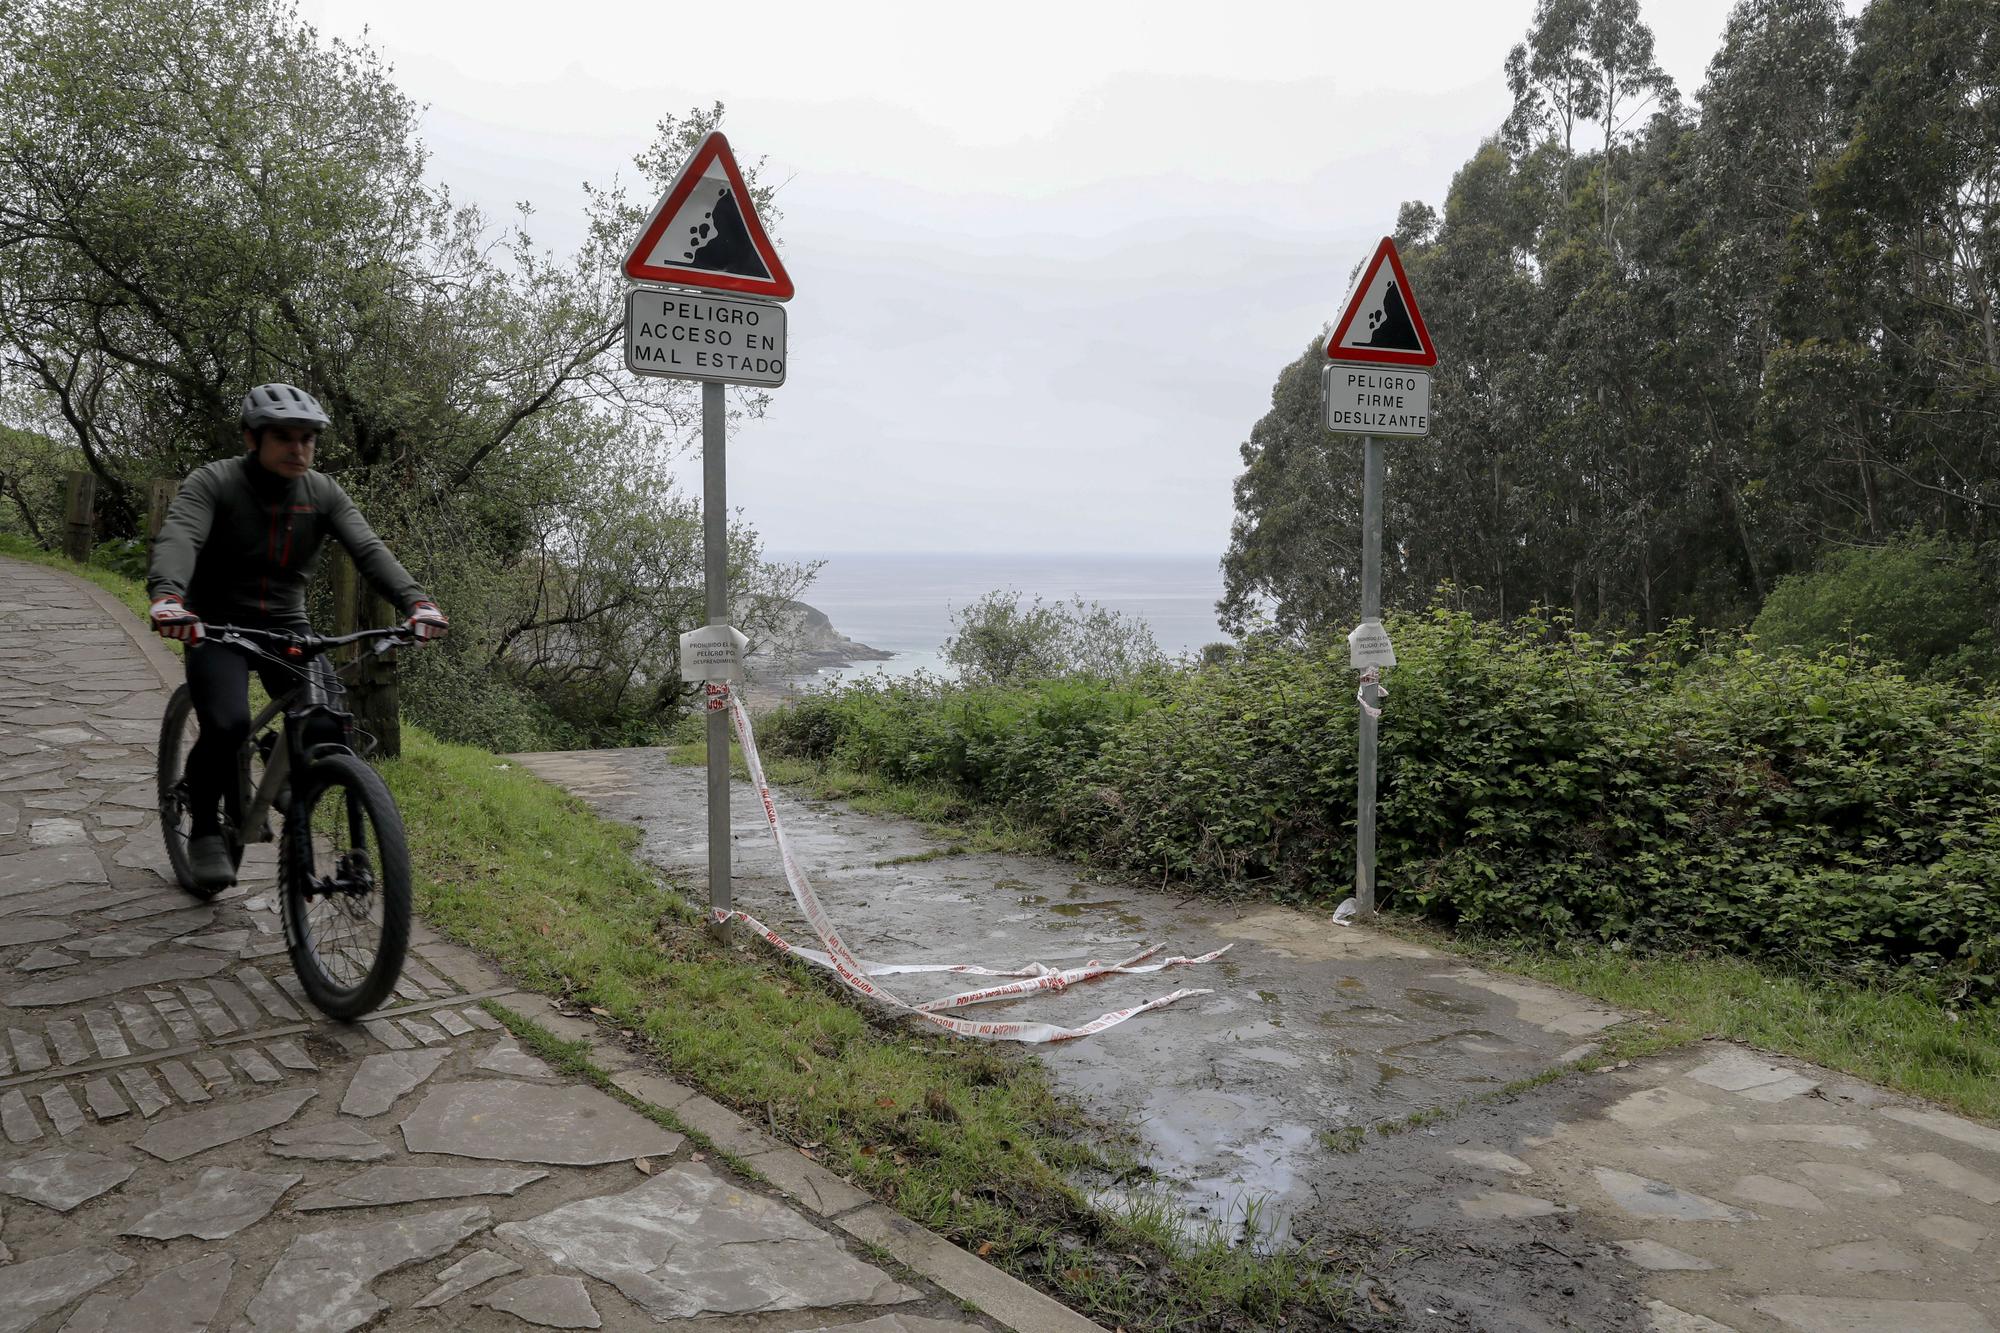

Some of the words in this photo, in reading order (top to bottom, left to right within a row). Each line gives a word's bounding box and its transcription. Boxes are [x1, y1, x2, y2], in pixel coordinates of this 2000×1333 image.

[662, 301, 760, 327] PELIGRO
[639, 322, 733, 346] ACCESO
[746, 334, 775, 351] EN
[635, 345, 682, 365] MAL
[696, 351, 783, 375] ESTADO
[1347, 374, 1416, 391] PELIGRO
[1357, 393, 1404, 409] FIRME
[1334, 411, 1427, 428] DESLIZANTE
[836, 963, 853, 980] local
